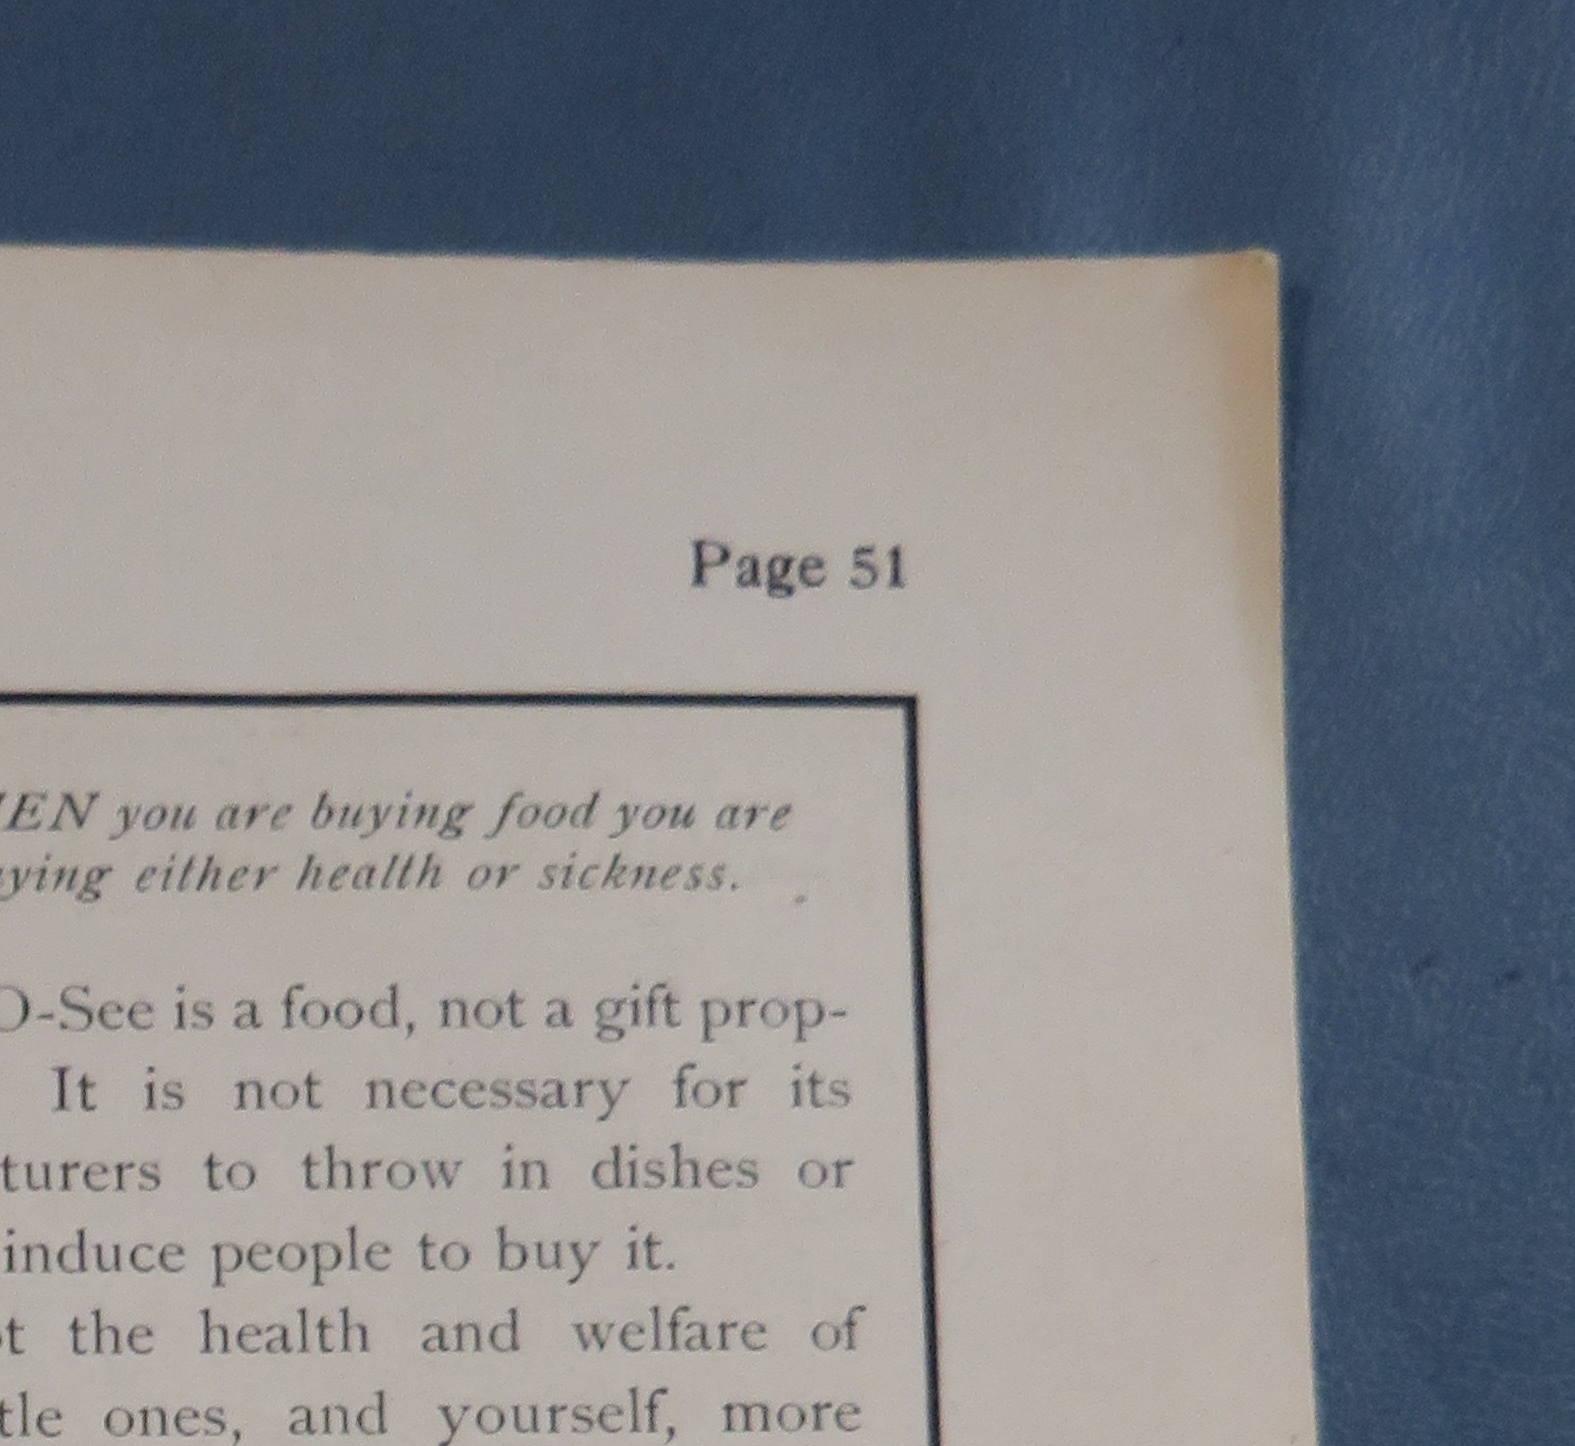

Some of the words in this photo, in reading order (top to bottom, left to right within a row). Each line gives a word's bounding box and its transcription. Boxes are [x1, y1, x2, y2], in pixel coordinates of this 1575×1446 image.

[691, 538, 826, 599] Page
[850, 545, 905, 590] 51
[109, 805, 195, 840] you
[216, 804, 292, 830] are
[311, 790, 474, 840] buying
[484, 791, 600, 839] food
[609, 803, 695, 838] you
[716, 804, 792, 831] are
[136, 854, 278, 893] either
[297, 852, 441, 891] health
[468, 864, 520, 889] or
[538, 852, 737, 890] sickness.
[175, 985, 214, 1030] is
[234, 1000, 262, 1029] a
[282, 983, 415, 1037] food,
[440, 990, 525, 1028] not
[546, 999, 573, 1028] a
[595, 982, 681, 1042] gift
[701, 998, 846, 1043] prop-
[204, 1153, 256, 1191] to
[302, 1144, 463, 1190] throw
[502, 1143, 549, 1189] in
[592, 1142, 758, 1189] dishes
[798, 1160, 854, 1188] or
[4, 1228, 185, 1274] induce
[212, 1225, 391, 1287] people
[419, 1233, 471, 1271] to
[496, 1225, 600, 1285] buy
[627, 1225, 674, 1270] it.
[104, 1406, 241, 1446] ones,
[289, 1390, 387, 1435] and
[723, 1402, 861, 1432] more
